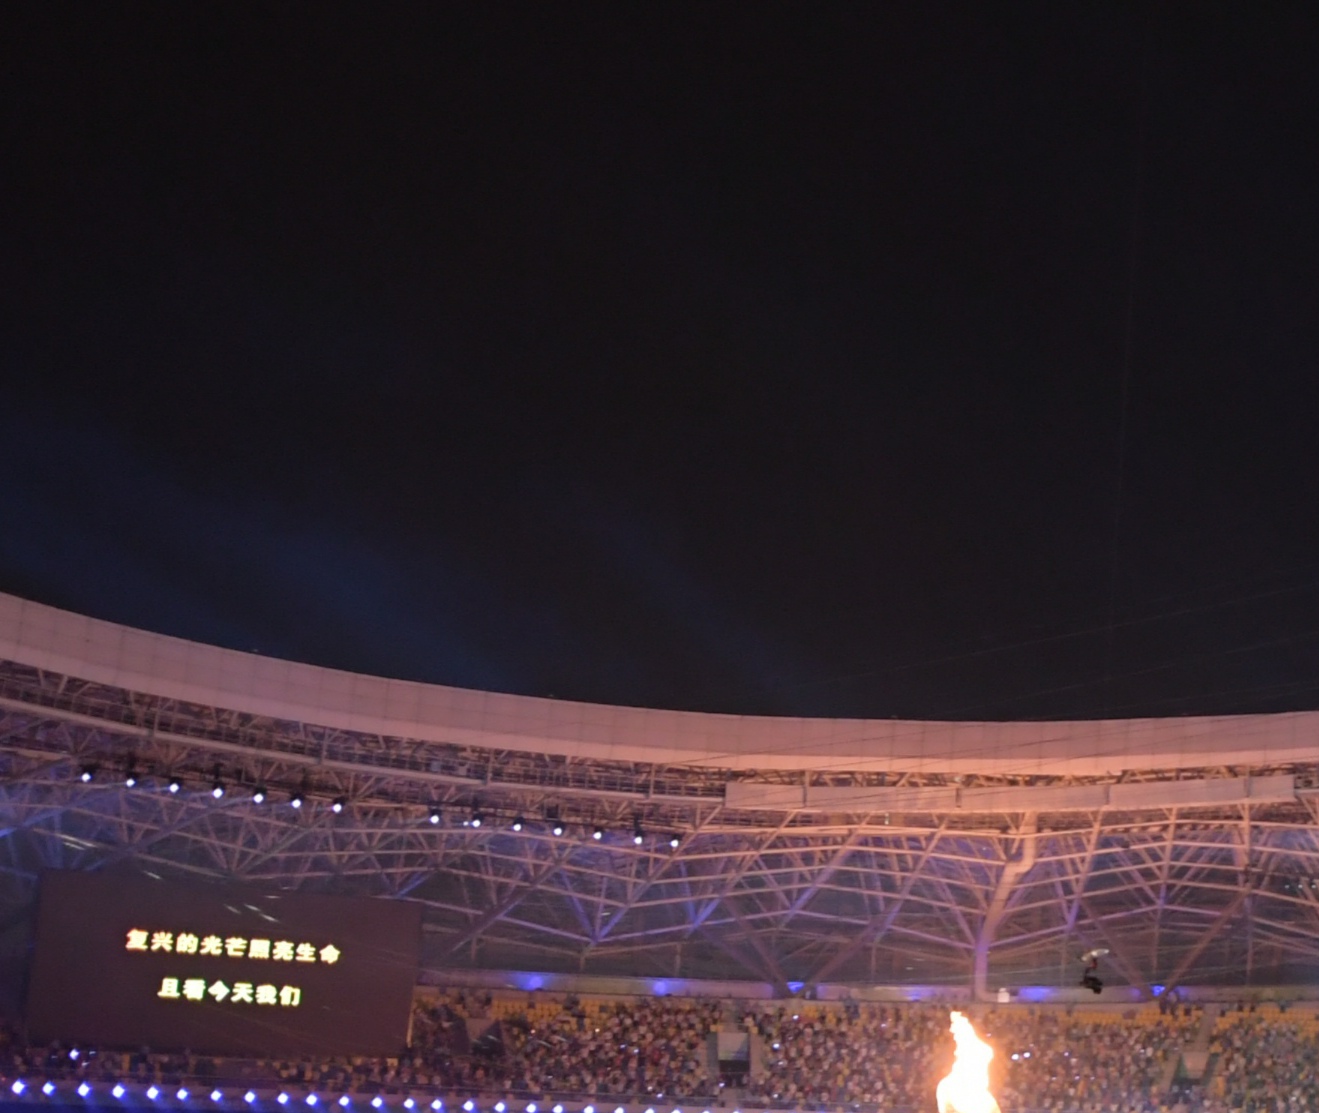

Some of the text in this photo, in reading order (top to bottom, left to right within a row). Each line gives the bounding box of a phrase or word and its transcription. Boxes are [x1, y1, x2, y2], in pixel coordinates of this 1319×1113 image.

[125, 928, 341, 964] 复兴的光芒照亮生命
[156, 976, 302, 1007] 且看今天我们
